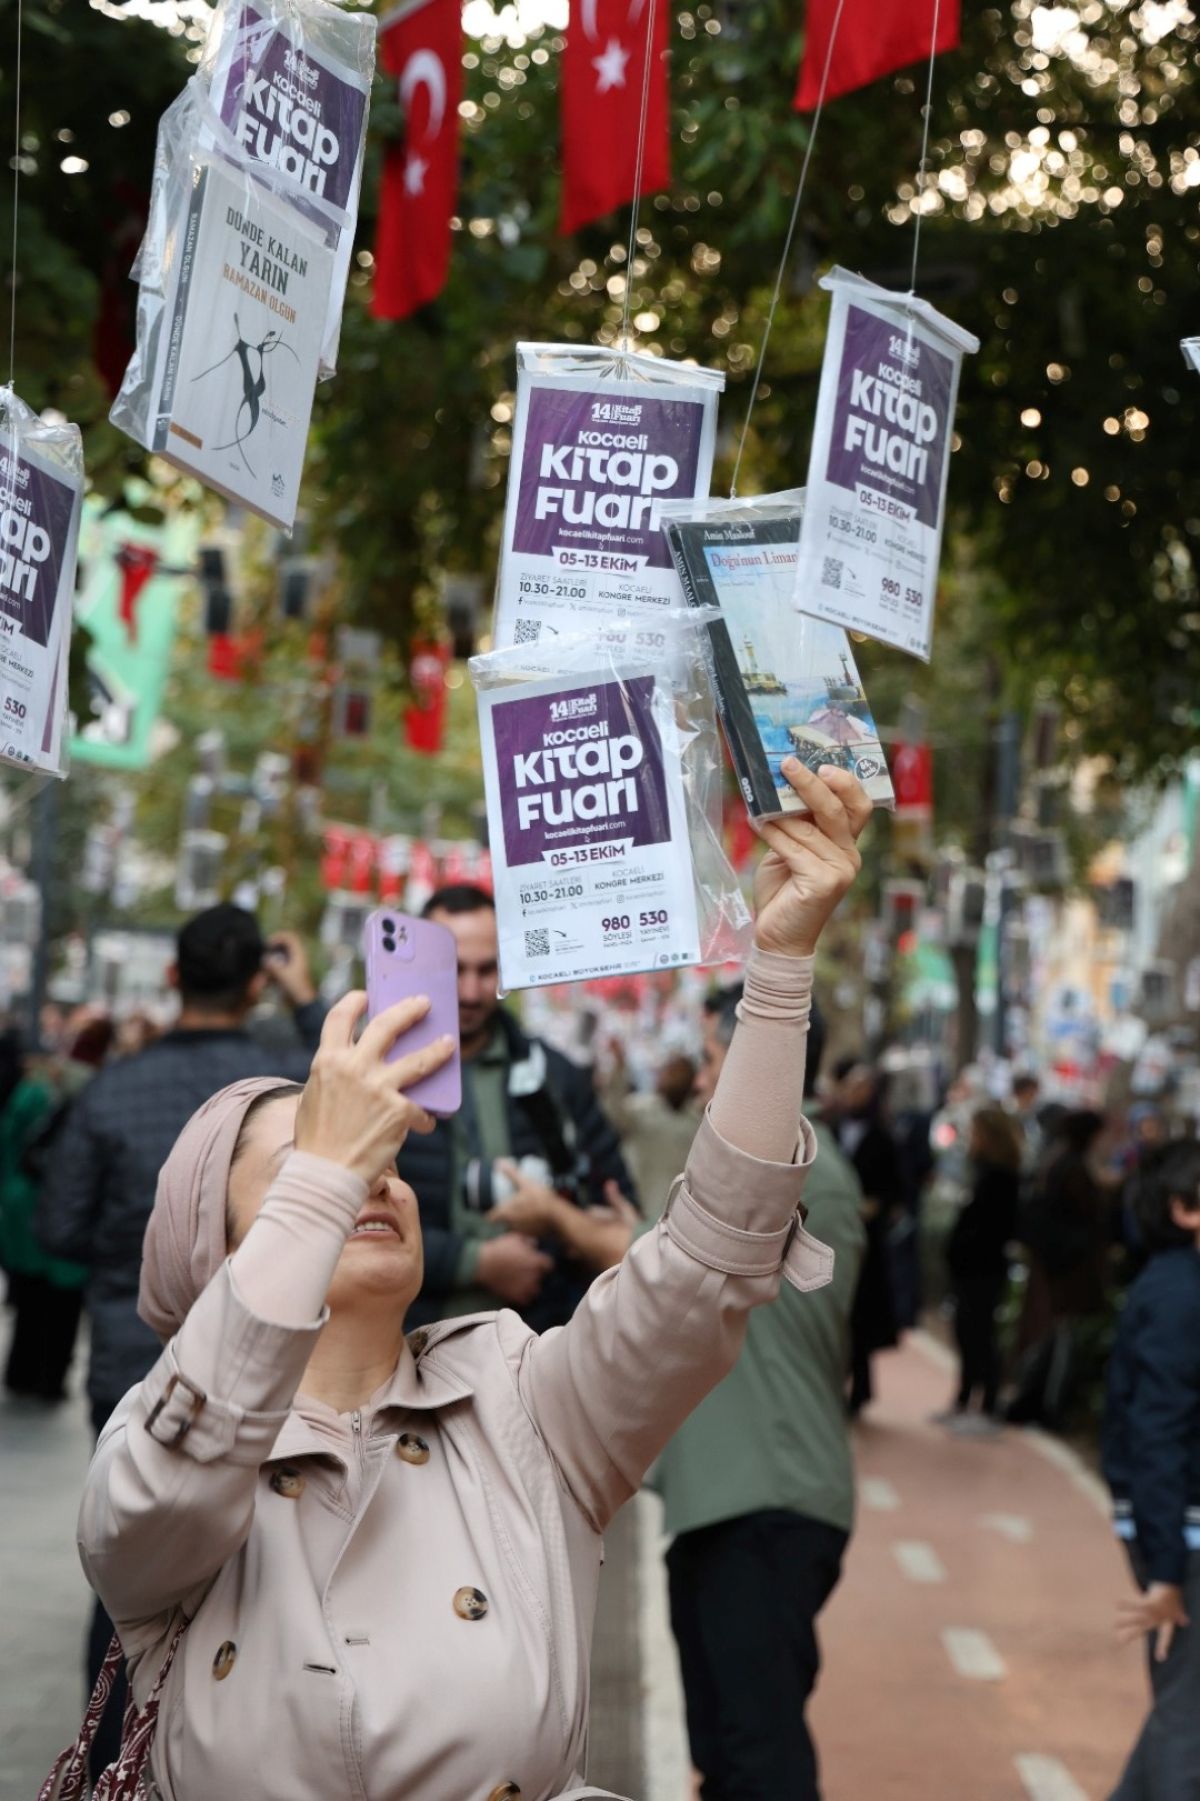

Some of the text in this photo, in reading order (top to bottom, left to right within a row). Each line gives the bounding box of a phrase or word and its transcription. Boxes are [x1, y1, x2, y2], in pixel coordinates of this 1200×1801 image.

[273, 71, 321, 117] Kocaeli
[246, 78, 339, 165] Kitap
[186, 212, 198, 252] RAMAZAN
[240, 241, 289, 295] YARIN
[268, 236, 308, 278] KALAN
[223, 262, 297, 323] RAMAZAN OLGUN
[591, 403, 611, 420] 14
[850, 369, 937, 445] Kitap
[578, 431, 648, 450] Kocaeli
[844, 414, 928, 485] Fuarı
[540, 443, 679, 495] Kitap
[535, 486, 661, 532] Fuarı
[859, 490, 887, 510] 05-13
[558, 528, 644, 544] kocaelikitapfuari.com
[704, 530, 723, 541] Amin
[829, 514, 877, 544] 10.30-21.00
[559, 552, 599, 568] 05-13
[674, 551, 688, 576] AMIN
[519, 581, 587, 599] 10.30-21.00
[598, 591, 632, 602] KONGRE
[881, 577, 900, 597] 980
[905, 587, 923, 607] 530
[4, 697, 27, 719] 530
[550, 700, 569, 719] 14
[543, 721, 609, 747] Kocaeli
[513, 735, 644, 788] Kitap
[517, 777, 639, 830] Fuarı
[544, 820, 626, 839] kocaelikitapfuari.com
[550, 850, 588, 867] 05-13
[594, 871, 664, 890] KONGRE MERKEZİ
[519, 884, 584, 904] 10.30-21.00
[601, 909, 668, 932] 980 530
